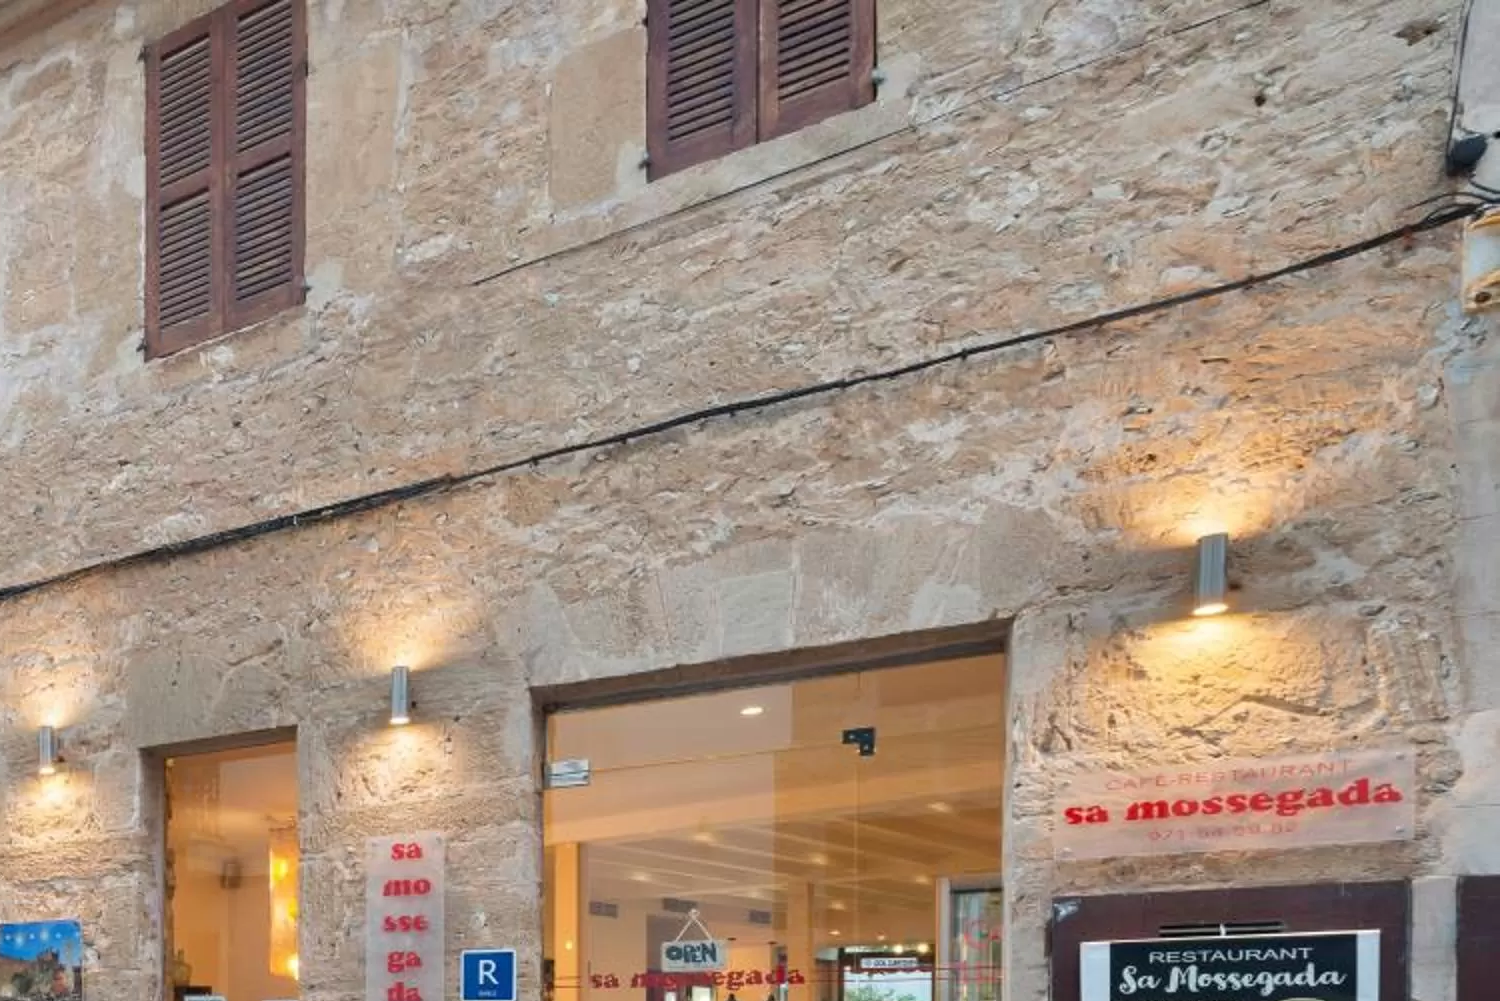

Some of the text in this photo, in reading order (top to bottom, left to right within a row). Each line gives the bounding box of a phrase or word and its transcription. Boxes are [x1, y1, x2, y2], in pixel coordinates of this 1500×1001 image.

[1064, 777, 1403, 826] sa mossegada
[390, 842, 423, 861] sa
[382, 878, 432, 897] mo
[383, 914, 430, 933] sse
[387, 951, 422, 974] ga
[665, 942, 717, 963] OPEN
[1150, 947, 1313, 964] RESTAURANT
[478, 959, 499, 985] R
[631, 963, 805, 990] megada
[1119, 961, 1347, 996] Sa Mossegada
